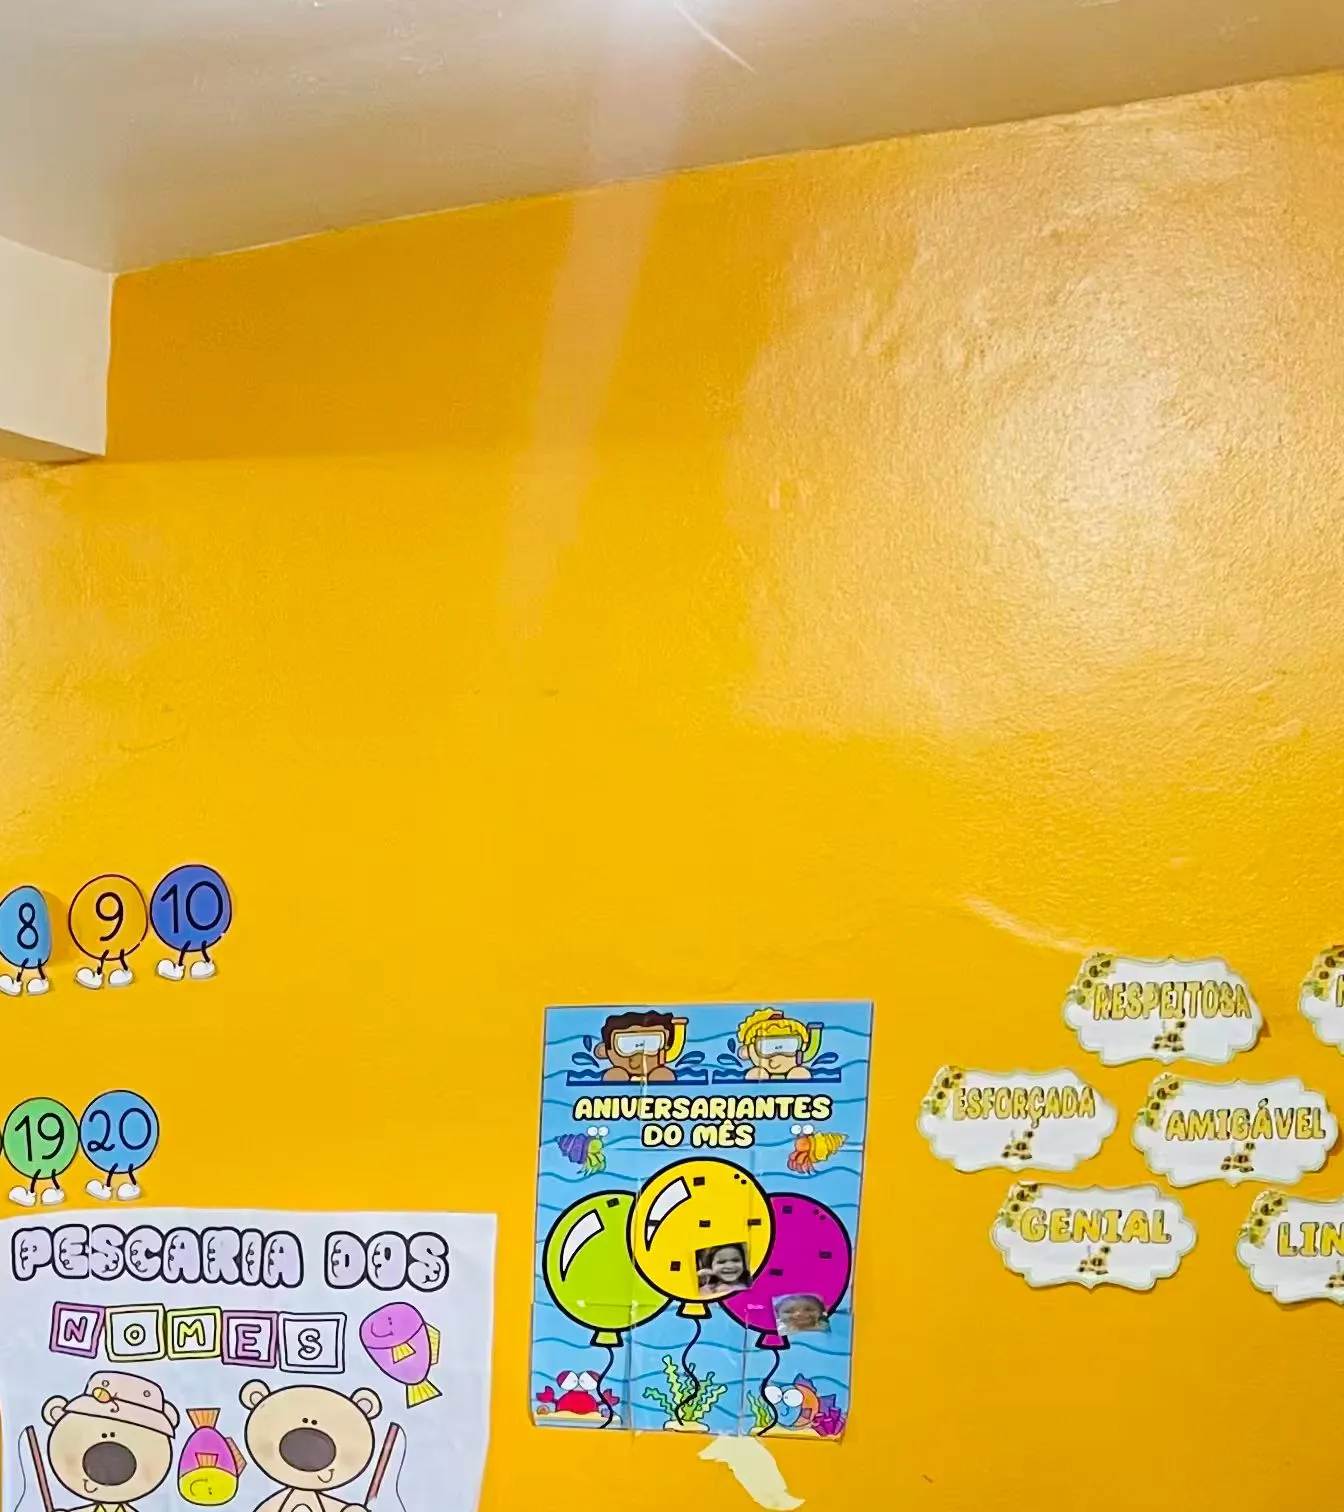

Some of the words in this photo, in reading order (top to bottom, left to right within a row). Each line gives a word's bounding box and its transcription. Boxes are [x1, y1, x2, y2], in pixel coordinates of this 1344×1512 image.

[17, 903, 38, 950] 8
[96, 892, 123, 941] 9
[160, 881, 223, 934] 10
[1093, 980, 1252, 1021] RESPEITOSA
[574, 1096, 831, 1121] ANIVERSARIANTES
[953, 1086, 1095, 1128] ESFORÇADA
[1165, 1098, 1326, 1141] AMIGÁVEL
[15, 1112, 64, 1161] 19
[87, 1108, 151, 1152] 20
[642, 1123, 685, 1147] DO
[692, 1119, 755, 1147] MÊS
[1019, 1208, 1171, 1244] GENIAL
[12, 1223, 303, 1288] PESCARIA
[324, 1231, 450, 1291] DOS
[62, 1314, 323, 1362] NOMES
